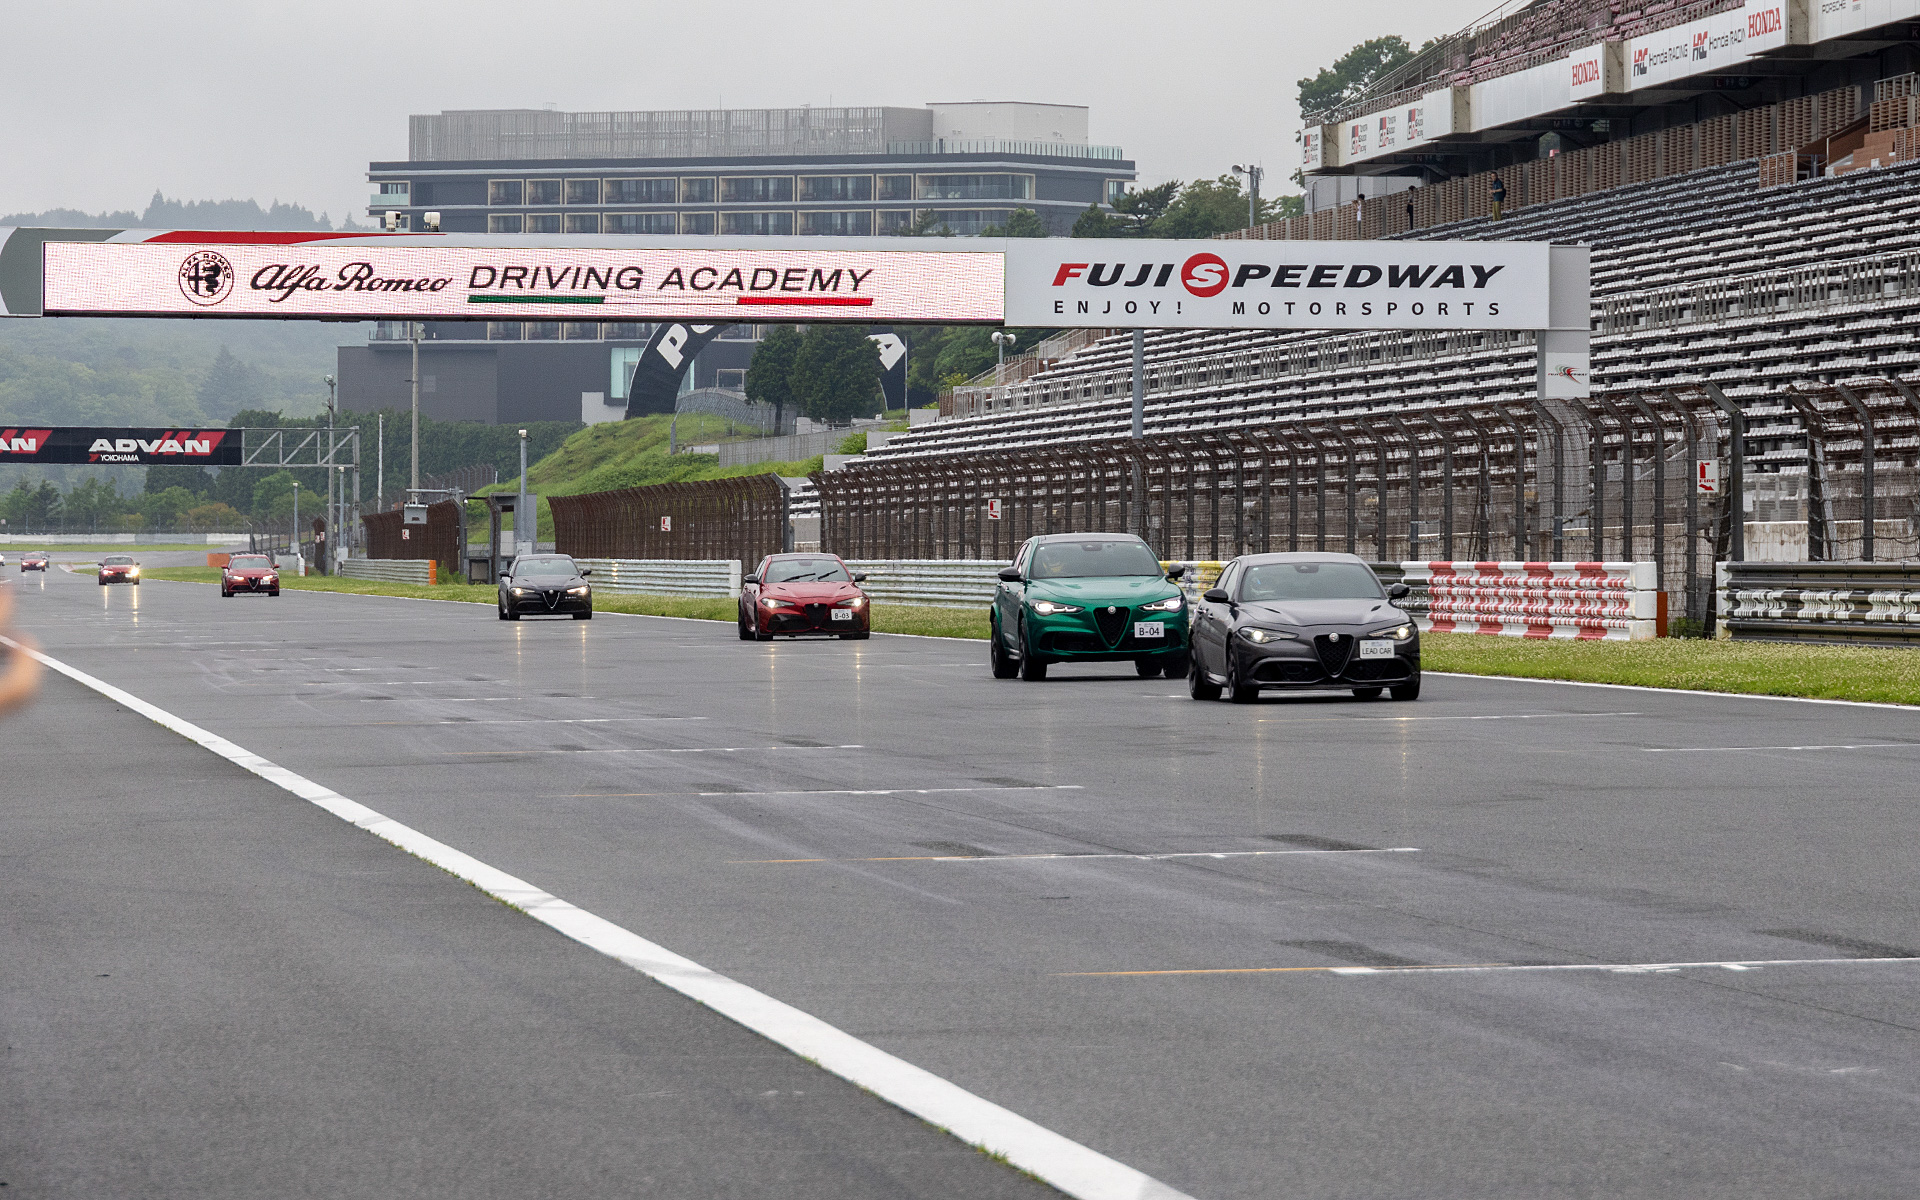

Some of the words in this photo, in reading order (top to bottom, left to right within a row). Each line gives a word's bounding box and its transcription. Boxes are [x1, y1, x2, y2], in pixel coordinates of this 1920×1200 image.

[1748, 7, 1782, 38] HONDA
[1708, 31, 1728, 50] Honda
[1648, 48, 1668, 67] Honda
[1669, 43, 1688, 61] RACING
[1572, 59, 1600, 86] HONDA
[250, 263, 334, 303] Alfa
[333, 261, 453, 292] Romeo
[468, 266, 644, 290] DRIVING
[657, 267, 874, 291] ACADEMY
[1051, 263, 1175, 287] FUJI
[1054, 300, 1182, 314] ENJOY!
[1232, 301, 1499, 315] MOTORSPORTS
[89, 439, 210, 453] ADVAN
[100, 454, 139, 462] YOKOHAMA
[1139, 627, 1160, 636] B-04
[1362, 647, 1378, 655] LEAD
[1379, 647, 1392, 655] CAR
